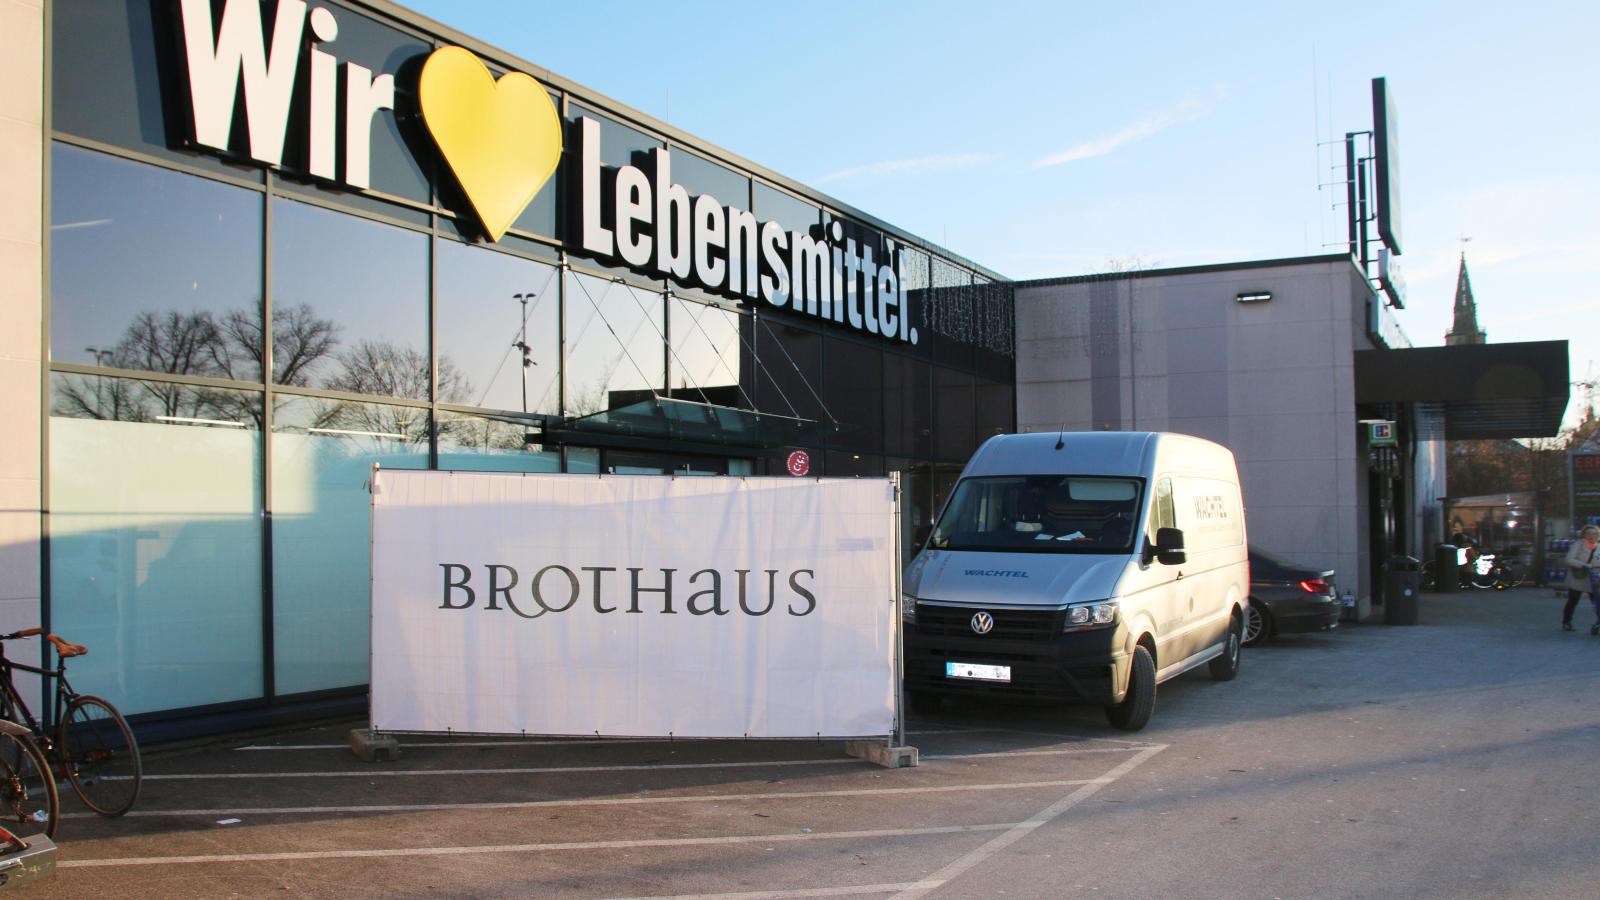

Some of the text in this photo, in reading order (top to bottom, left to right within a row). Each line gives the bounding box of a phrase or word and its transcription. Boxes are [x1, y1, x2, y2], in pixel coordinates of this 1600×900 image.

[180, 0, 919, 346] Wir Lebensmittel.
[964, 569, 1029, 578] WACHTEL
